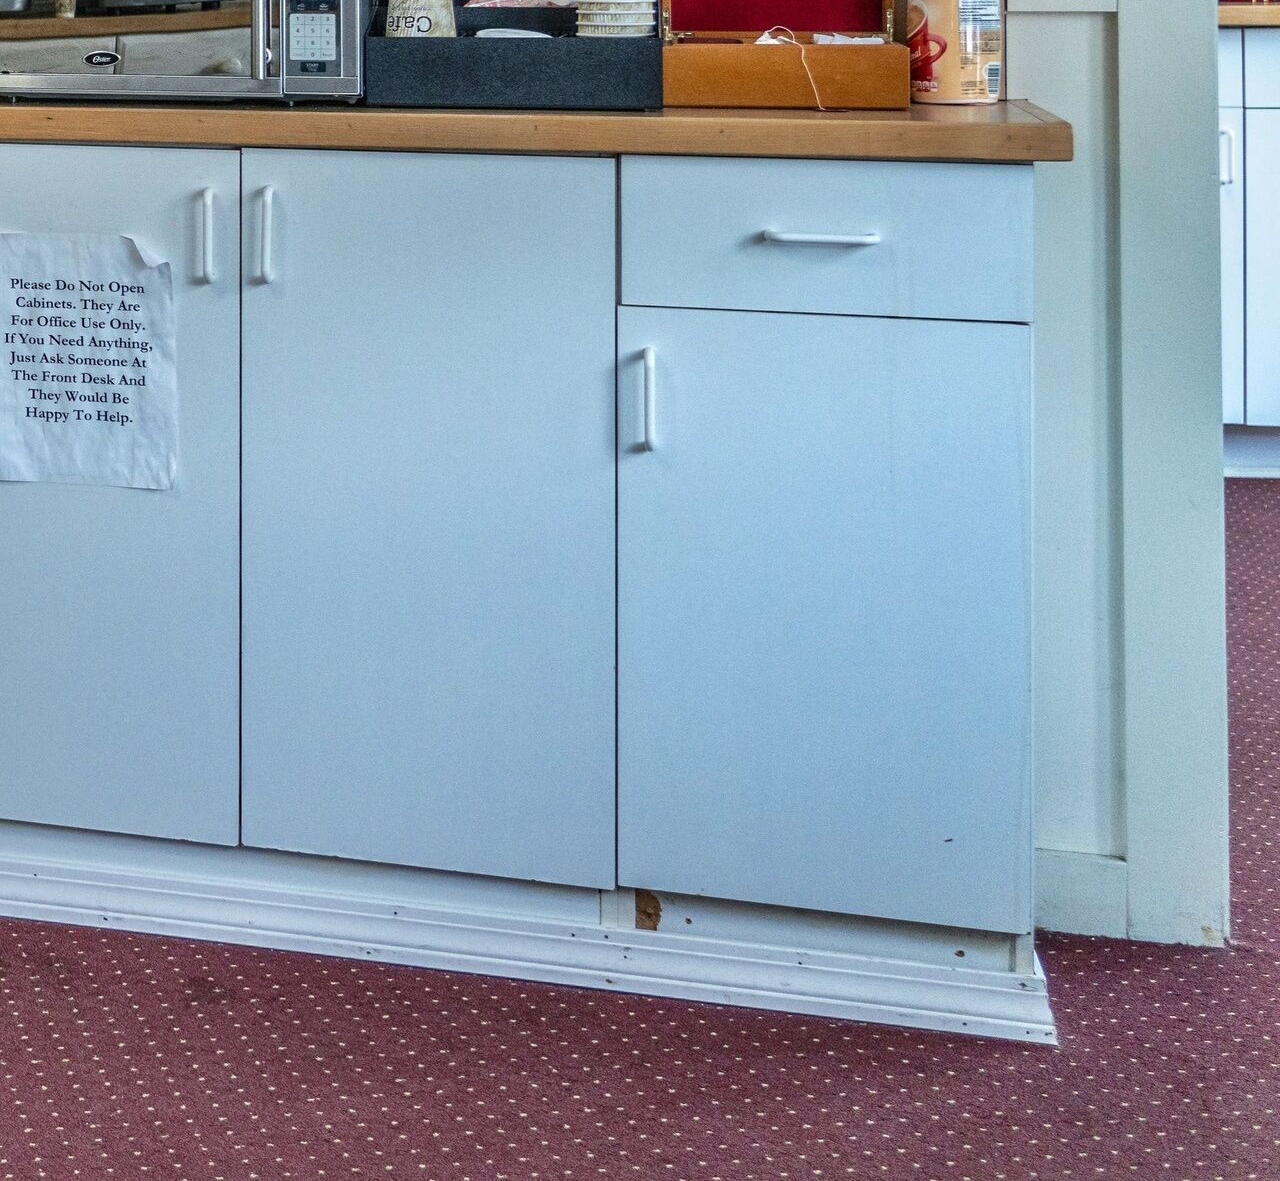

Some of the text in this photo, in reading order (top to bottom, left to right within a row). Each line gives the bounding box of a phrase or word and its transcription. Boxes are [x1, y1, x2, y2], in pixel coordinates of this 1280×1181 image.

[387, 15, 432, 33] Café
[92, 55, 111, 64] Oster
[10, 278, 145, 296] Please Do Not Open
[15, 296, 140, 313] Cabinets. They Are
[11, 315, 145, 333] For Office Use Only.
[4, 333, 153, 352] If You Need Anything,
[9, 351, 147, 368] Just Ask Someone At
[11, 370, 146, 386] The Front Desk And
[28, 388, 129, 404] They Would Be
[25, 407, 133, 426] Happy To Help.
